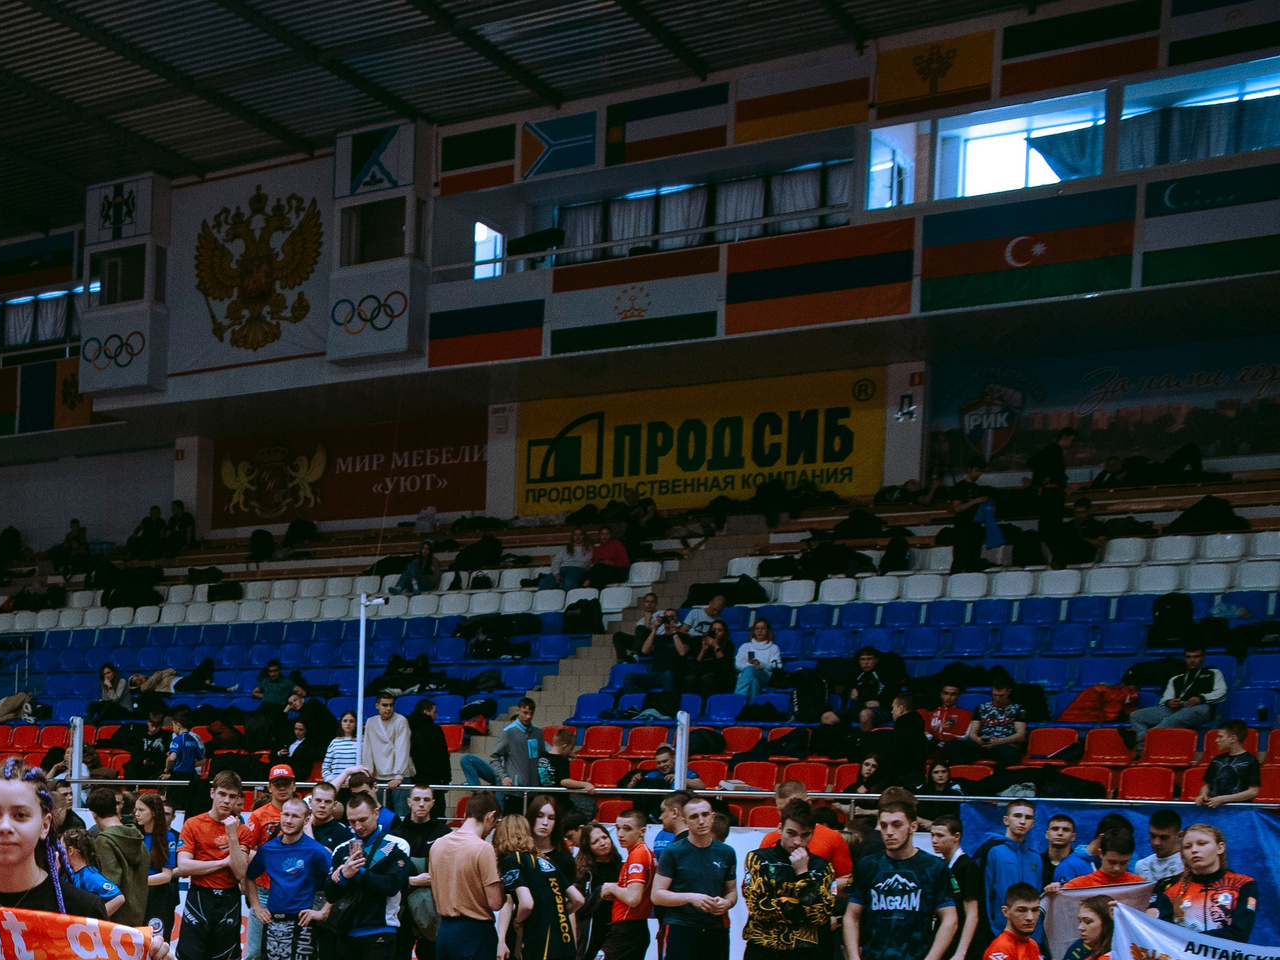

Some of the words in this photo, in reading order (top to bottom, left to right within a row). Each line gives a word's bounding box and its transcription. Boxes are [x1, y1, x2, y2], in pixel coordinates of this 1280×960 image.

[613, 406, 855, 477] ПРОДСИБ
[336, 453, 385, 475] МИР
[391, 443, 488, 470] МЕБЕЛИ
[371, 473, 448, 495] «УЮТ»
[871, 888, 922, 912] BAGRAM
